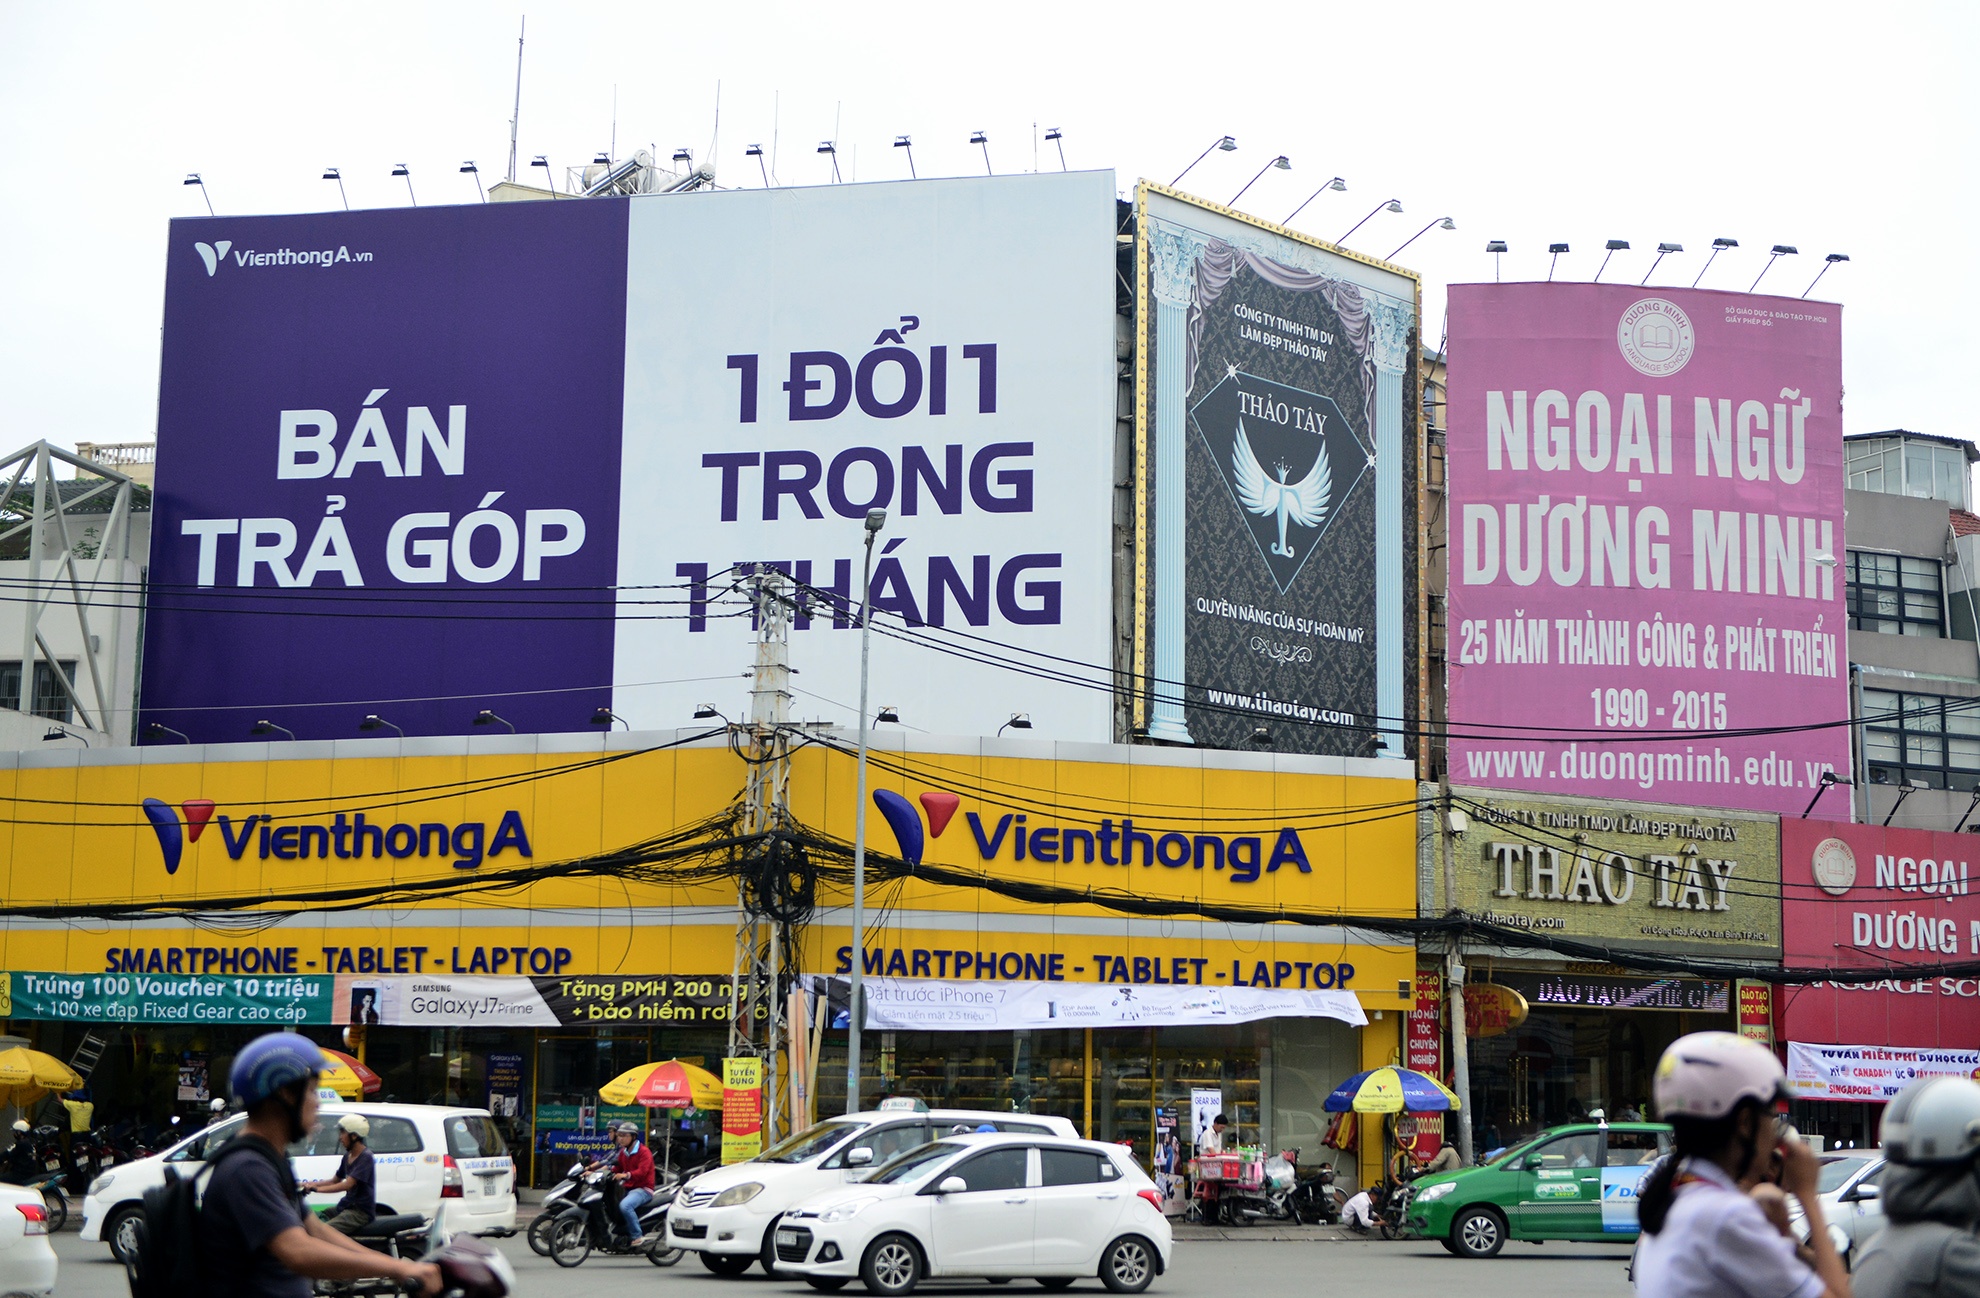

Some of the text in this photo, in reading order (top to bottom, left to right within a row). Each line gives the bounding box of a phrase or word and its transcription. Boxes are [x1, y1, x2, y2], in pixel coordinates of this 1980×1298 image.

[235, 245, 373, 268] VienthongA.vn
[1234, 304, 1333, 345] CÔNG TY TNHH TM DV
[1663, 305, 1687, 329] MINH
[1736, 306, 1752, 315] GIÁO
[1790, 313, 1803, 322] TẠO
[1804, 315, 1827, 323] TP.HCM
[1241, 325, 1327, 362] LÀM ĐẸP THẢO TÂY
[1624, 342, 1688, 372] LANGUAGE SCHOOL
[727, 315, 997, 423] 1 ĐỔI 1
[1237, 391, 1327, 435] THẢO TÂY
[277, 388, 467, 480] BÁN
[1486, 387, 1811, 492] NGOẠI NGỮ
[702, 441, 1034, 522] TRONG
[181, 491, 586, 589] TRẢ GÓP
[1463, 495, 1833, 600] DƯƠNG MINH
[675, 537, 1062, 633] 1 THÁNG
[1197, 598, 1364, 643] QUYỀN NĂNG CỦA SỰ HOÀN MỸ
[1460, 609, 1837, 678] 25 NĂM THÀNH CÔNG & PHÁT TRIỂN
[1208, 689, 1354, 725] www.thaotay.com
[1591, 688, 1727, 730] 1990 2015
[217, 810, 532, 869] VienthongA
[1521, 810, 1539, 823] TY
[1544, 812, 1580, 828] TNHH
[1622, 814, 1648, 834] LÀM
[1652, 820, 1677, 841] ĐẸP
[1678, 818, 1715, 840] THẢO
[1717, 822, 1739, 841] TÂY
[965, 811, 1312, 883] VienthongA
[1491, 833, 1738, 911] THẢO TÂY
[1875, 855, 1968, 902] NGOẠI
[1853, 910, 1957, 954] DƯƠNG
[106, 946, 572, 975] SMARTPHONE TABLET LAPTOP
[836, 945, 1356, 990] SMARTPHONE TABLET LAPTOP
[23, 975, 320, 1002] Trúng 100 Voucher 10 triệu
[560, 980, 712, 1001] Tặng PMH 200
[866, 985, 1007, 1003] Đặt trước iPhone 7
[1741, 988, 1768, 1002] ĐÀO TẠO
[1939, 977, 1980, 996] SC
[50, 1000, 307, 1024] 100 xe đạp Fixed Gear cao cấp
[499, 1003, 533, 1014] Prime
[588, 1000, 732, 1020] bảo hiểm rơi
[949, 1011, 961, 1019] 2.5
[1409, 1009, 1422, 1021] TẠO
[1741, 1003, 1768, 1016] HỌC VIÊN
[1417, 1022, 1431, 1034] TÓC
[1410, 1038, 1438, 1050] CHUYÊN
[1894, 1051, 1917, 1062] PHÍ
[1935, 1055, 1956, 1064] HỌC
[1957, 1054, 1979, 1064] CÁC
[1411, 1052, 1437, 1067] NGHIỆP
[1852, 1068, 1884, 1078] CANADA
[730, 1078, 754, 1086] DỤNG
[1829, 1084, 1872, 1095] SINGAPORE
[1883, 1086, 1900, 1096] NEW
[1194, 1096, 1210, 1105] GEAR
[574, 1143, 590, 1151] ngay
